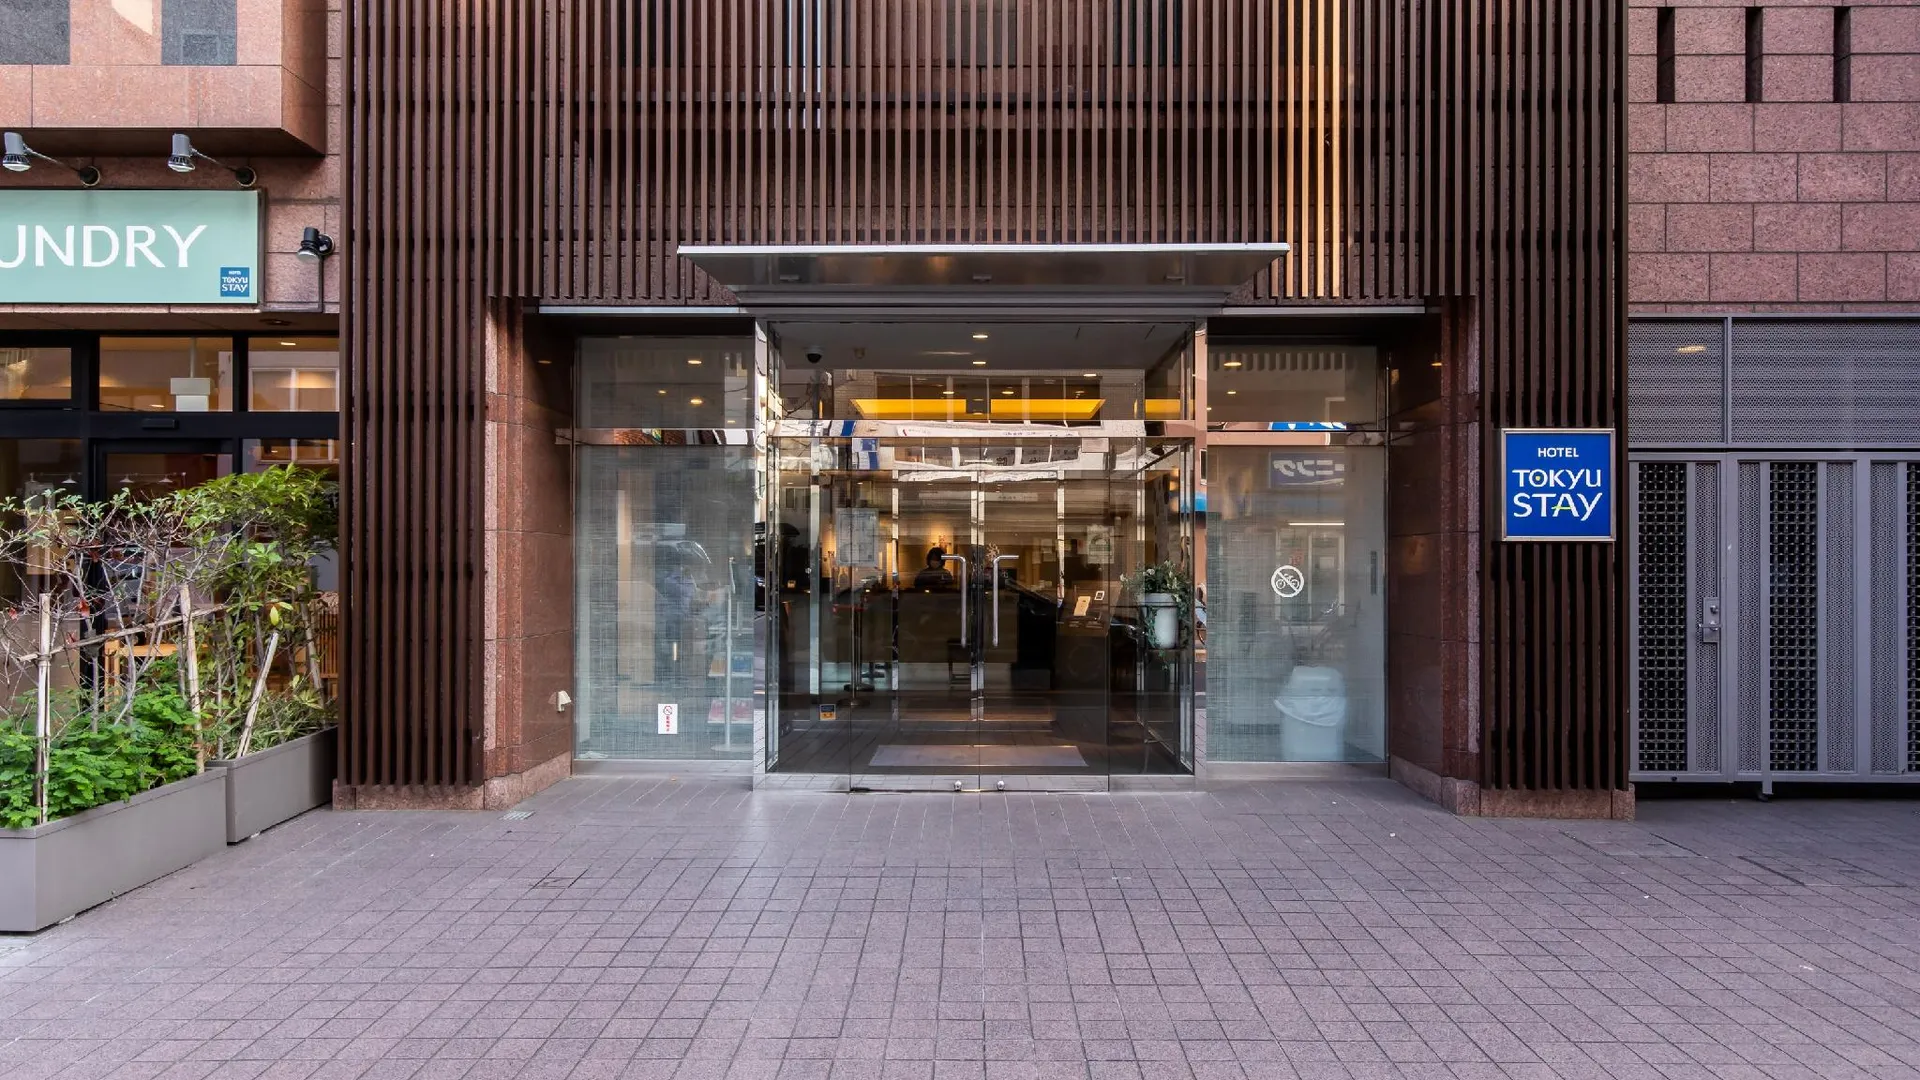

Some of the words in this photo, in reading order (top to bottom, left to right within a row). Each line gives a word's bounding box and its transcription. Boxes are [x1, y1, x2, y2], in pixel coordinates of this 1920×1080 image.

[0, 224, 209, 269] UNDRY
[221, 276, 248, 284] TOKYU
[221, 283, 248, 293] STAY
[1537, 447, 1580, 458] HOTEL
[1511, 468, 1602, 490] TOKYU
[1513, 492, 1603, 522] STAY
